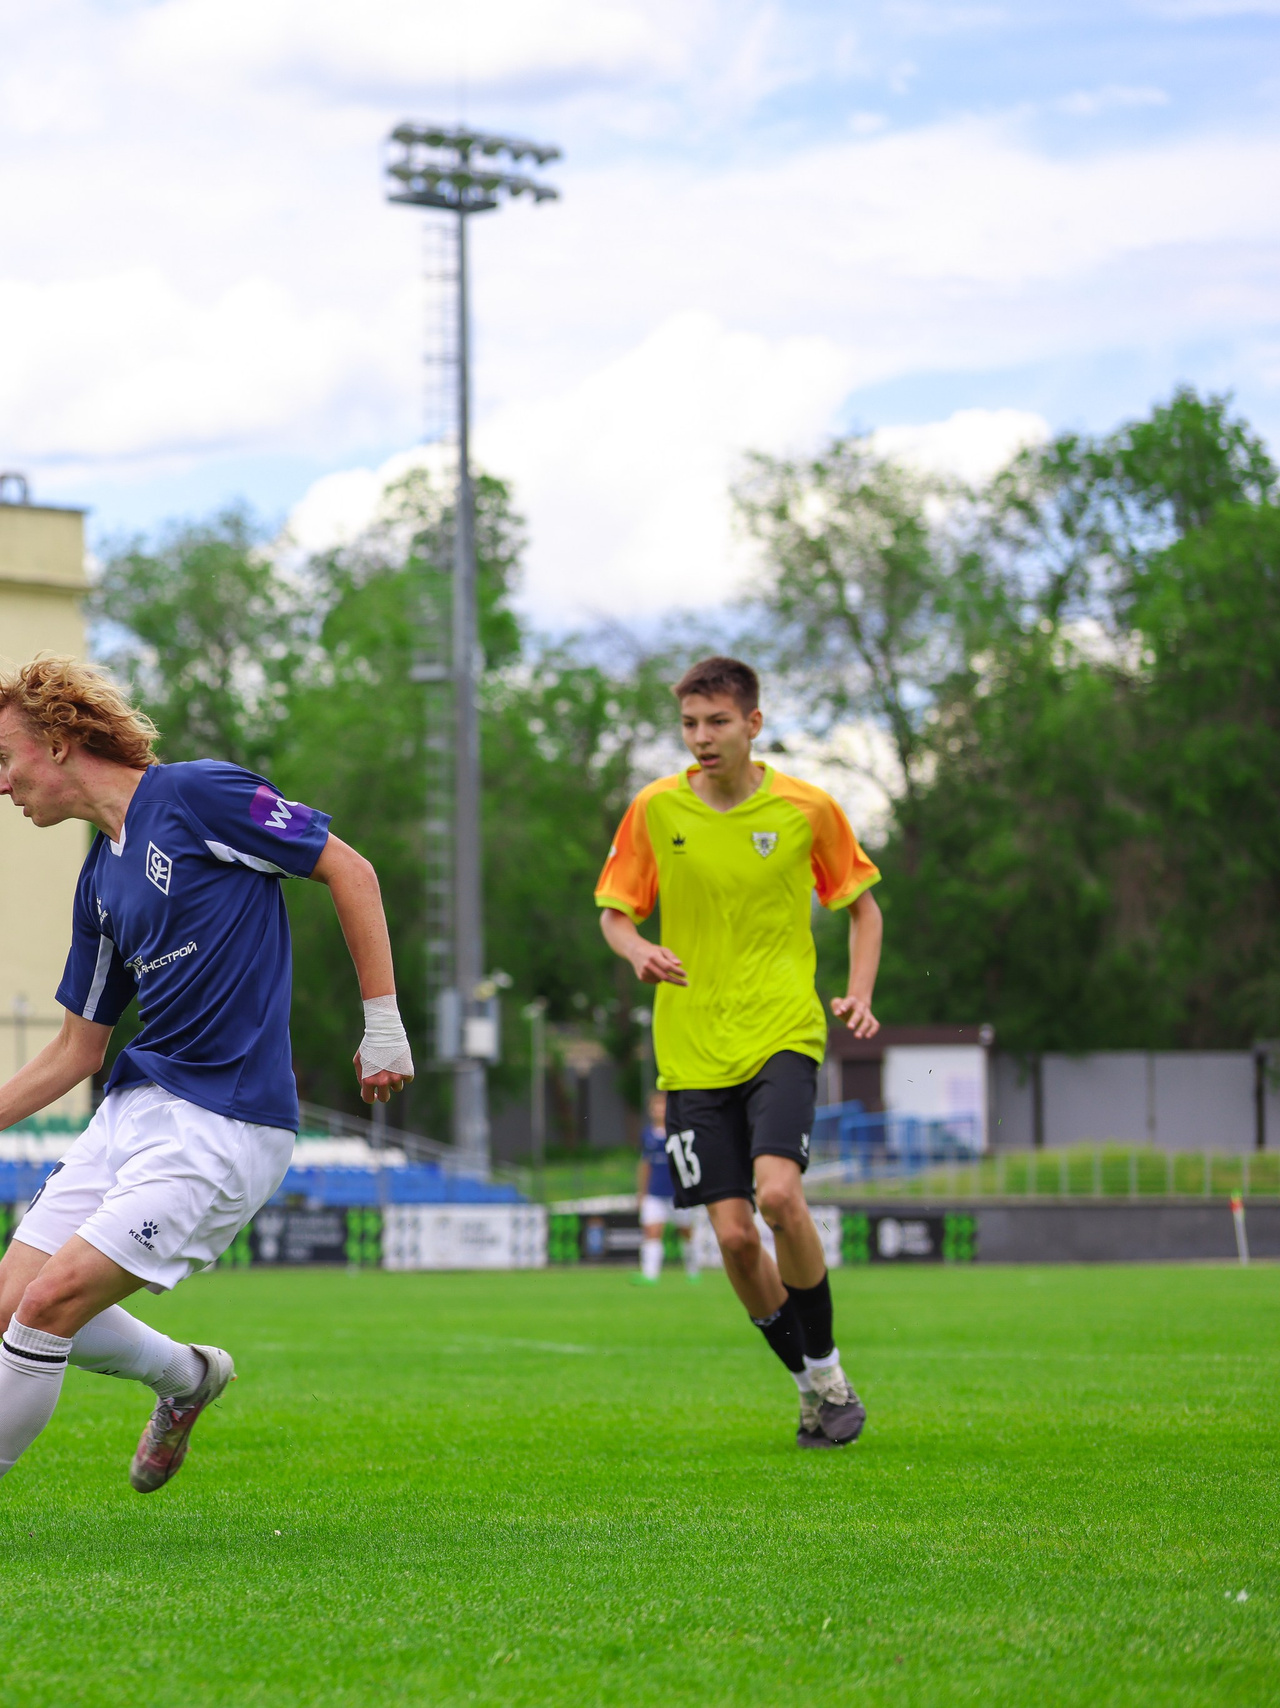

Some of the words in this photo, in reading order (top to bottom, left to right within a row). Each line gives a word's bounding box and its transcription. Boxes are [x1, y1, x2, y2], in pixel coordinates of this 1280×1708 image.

[140, 941, 198, 974] АНССТРОЙ
[665, 1129, 702, 1189] 13
[128, 1228, 155, 1251] KELME
